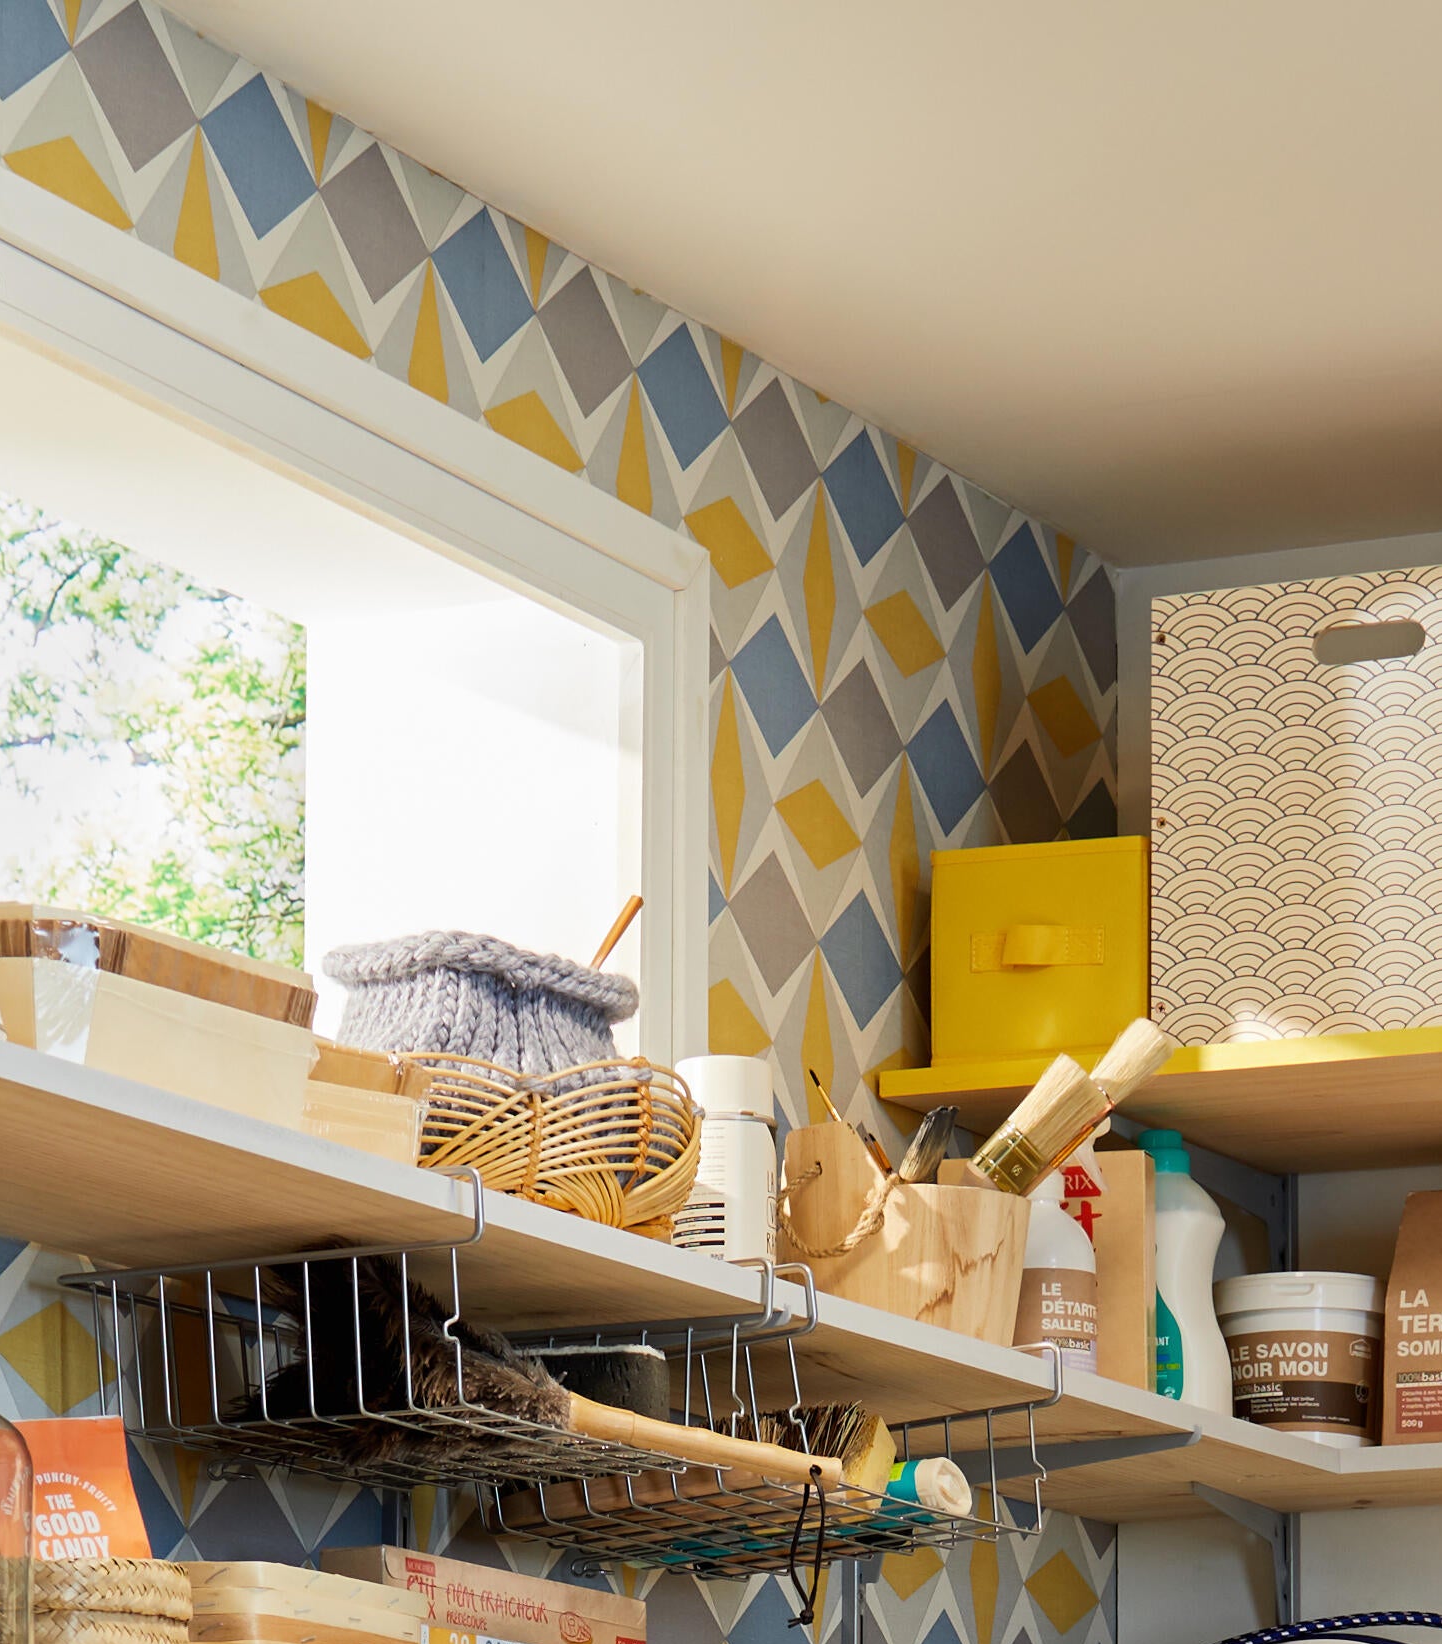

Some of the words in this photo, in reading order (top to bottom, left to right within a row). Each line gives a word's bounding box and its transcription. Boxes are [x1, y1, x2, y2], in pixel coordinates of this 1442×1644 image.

[1041, 1282, 1062, 1297] LE
[1399, 1288, 1430, 1309] LA
[1041, 1317, 1082, 1332] SALLE
[1083, 1321, 1095, 1334] DE
[1230, 1344, 1251, 1364] LE
[1255, 1341, 1329, 1360] SAVON
[1232, 1361, 1273, 1382] NOIR
[1278, 1360, 1329, 1378] MOU
[45, 1493, 77, 1512] THE
[34, 1509, 102, 1538] GOOD
[38, 1534, 110, 1562] CANDY
